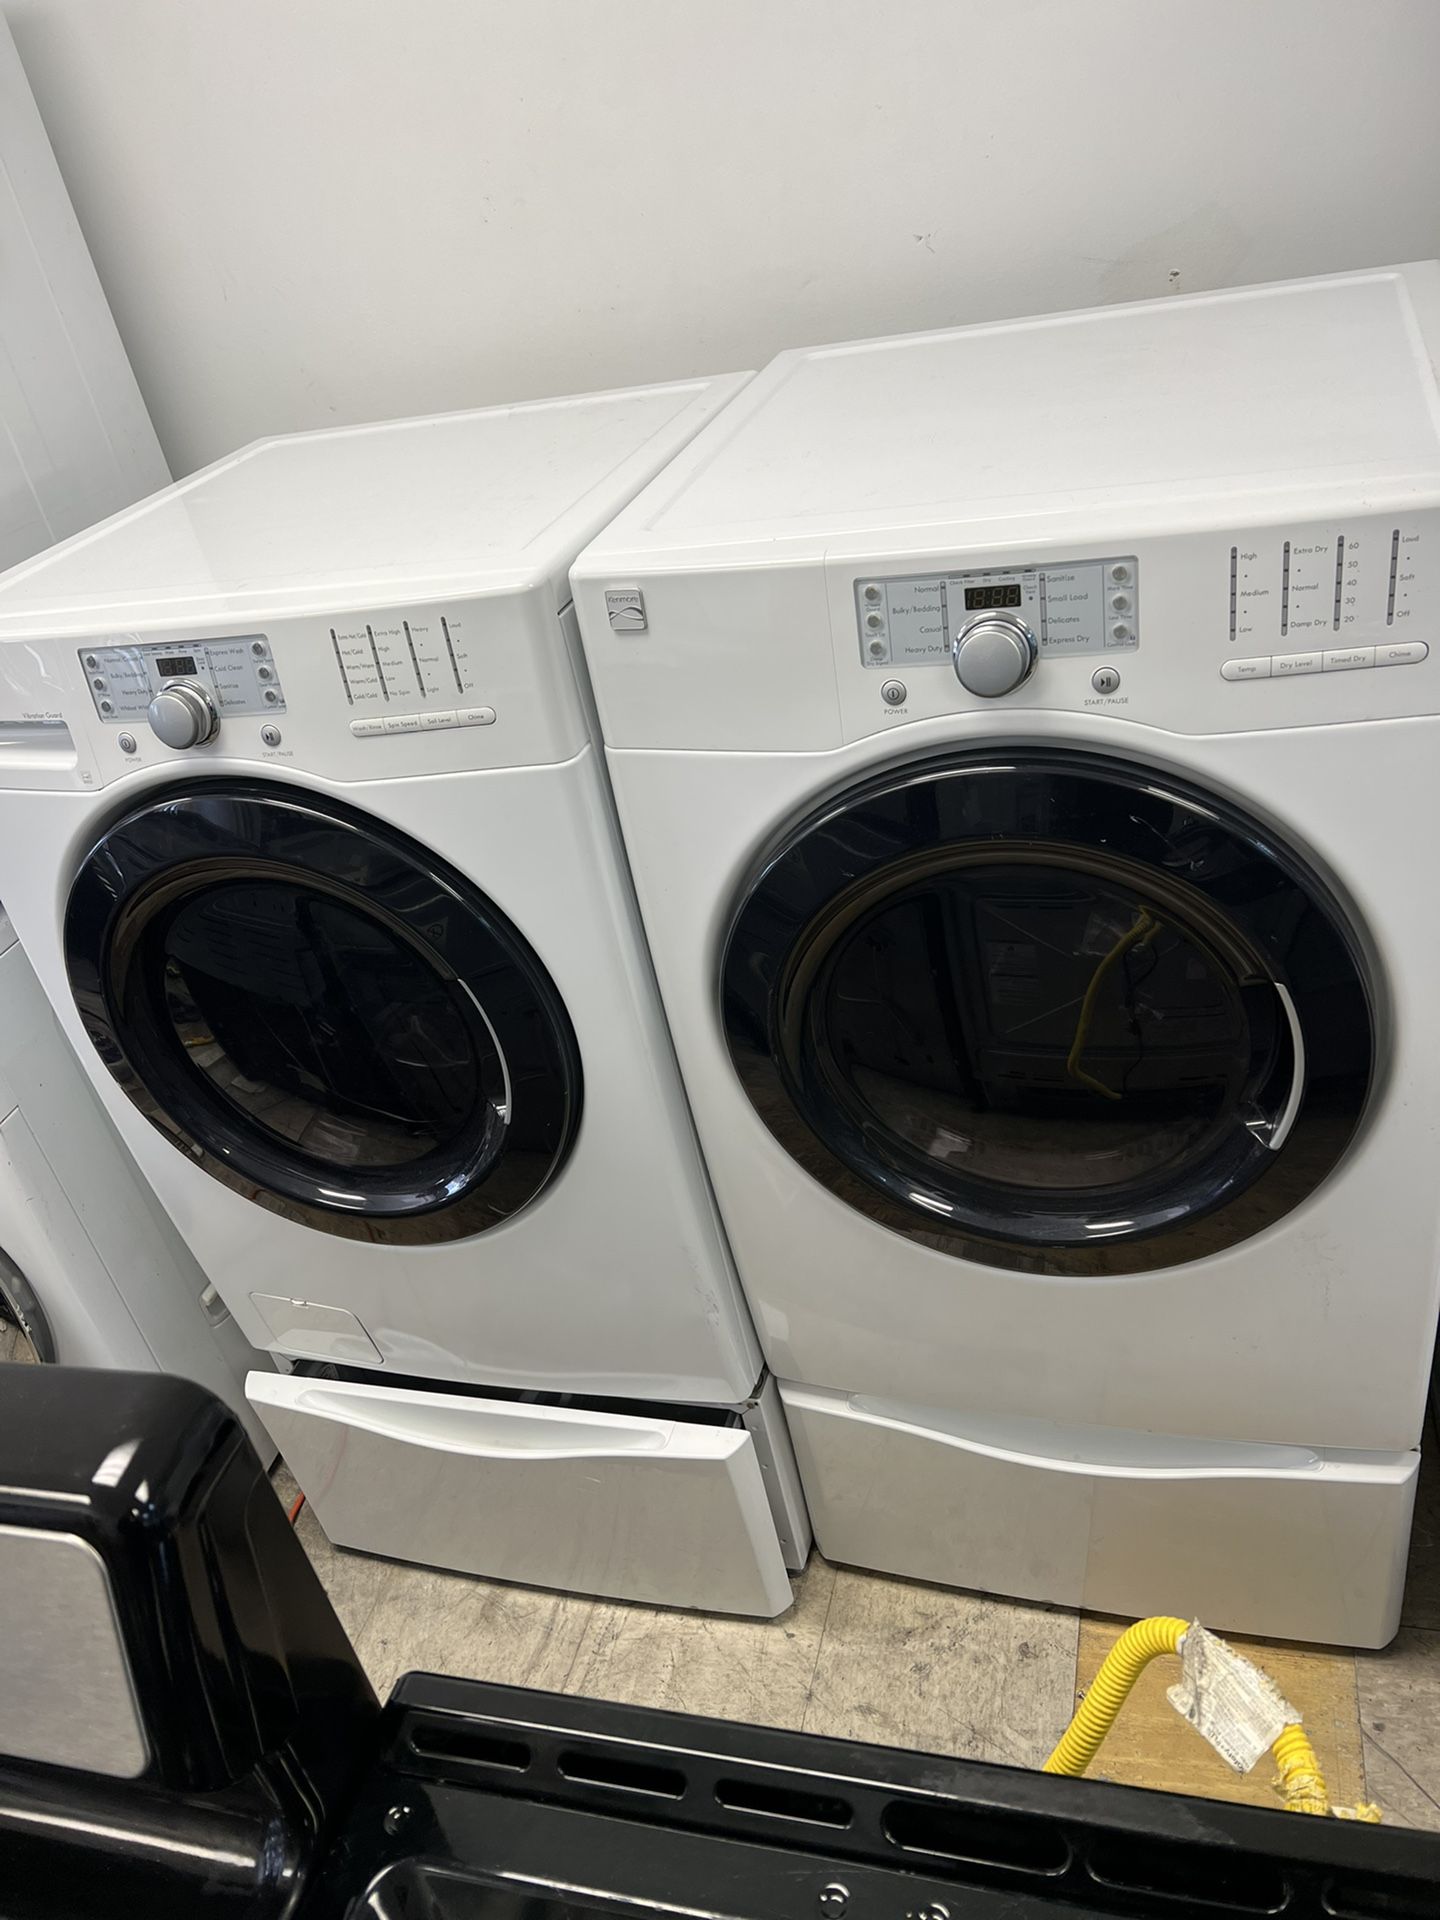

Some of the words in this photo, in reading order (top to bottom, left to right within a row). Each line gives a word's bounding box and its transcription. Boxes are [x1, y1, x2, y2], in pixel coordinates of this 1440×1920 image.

[1402, 535, 1420, 543] Loud
[1348, 541, 1359, 549] 60
[1294, 547, 1313, 555] Extra
[1315, 545, 1328, 554] Dry
[1240, 552, 1257, 560] High
[1347, 560, 1358, 568] 50
[1047, 575, 1075, 583] Sanitize
[1400, 573, 1415, 581] Soft
[1346, 579, 1357, 587] 40
[1292, 583, 1319, 592] Normal
[1240, 589, 1269, 597] Medium
[1048, 594, 1067, 603] Small
[1070, 593, 1088, 601] Load
[892, 605, 940, 615] Bulky/Bedding
[1396, 609, 1410, 617] Off
[1048, 617, 1080, 625] Delicates
[1290, 620, 1312, 629] Damp
[1314, 618, 1327, 627] Dry
[1049, 637, 1075, 645] Express
[1077, 635, 1090, 643] Dry
[905, 646, 926, 654] Heavy
[928, 644, 942, 653] Duty
[1331, 656, 1351, 664] Timed
[1352, 655, 1366, 663] Dry
[1280, 662, 1293, 670] Dry
[1294, 659, 1312, 668] Level
[1238, 666, 1257, 674] Temp
[1084, 697, 1129, 706] START/PAUSE
